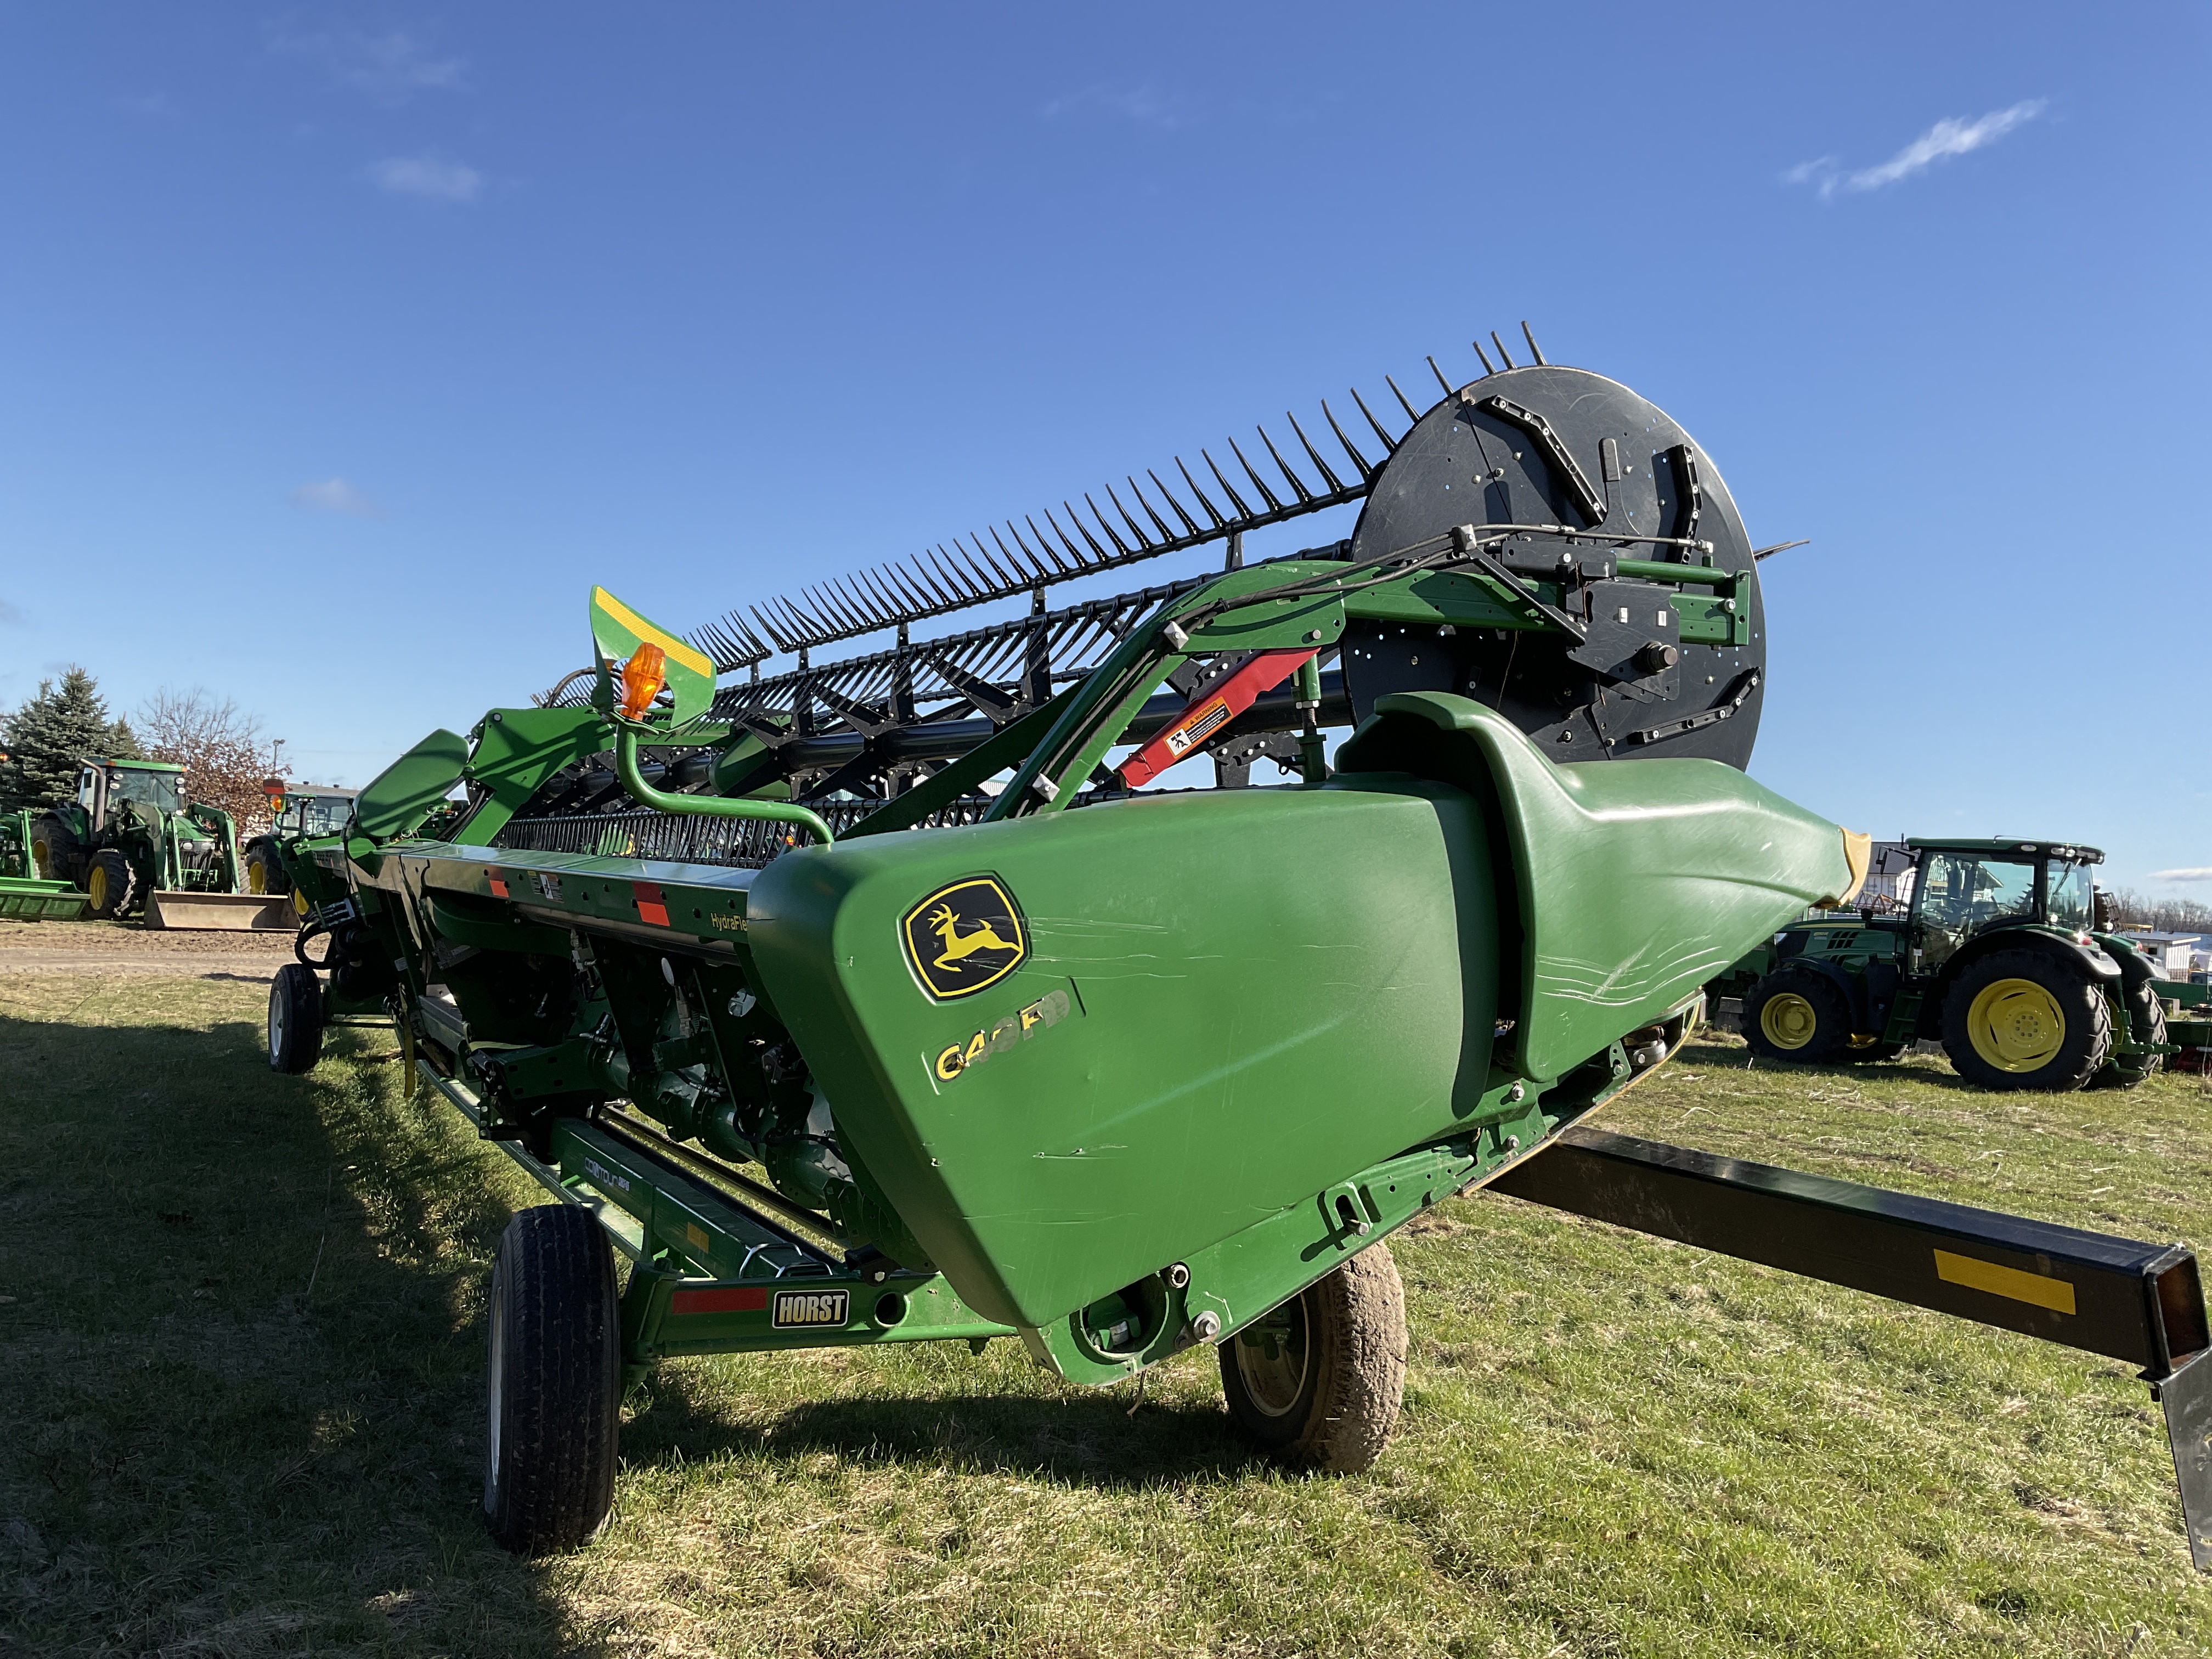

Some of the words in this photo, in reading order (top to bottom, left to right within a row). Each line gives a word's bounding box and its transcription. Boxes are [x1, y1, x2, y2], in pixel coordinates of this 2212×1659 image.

[1194, 702, 1218, 721] WARNING
[710, 912, 748, 932] HydraFle
[778, 1295, 845, 1323] HORST
